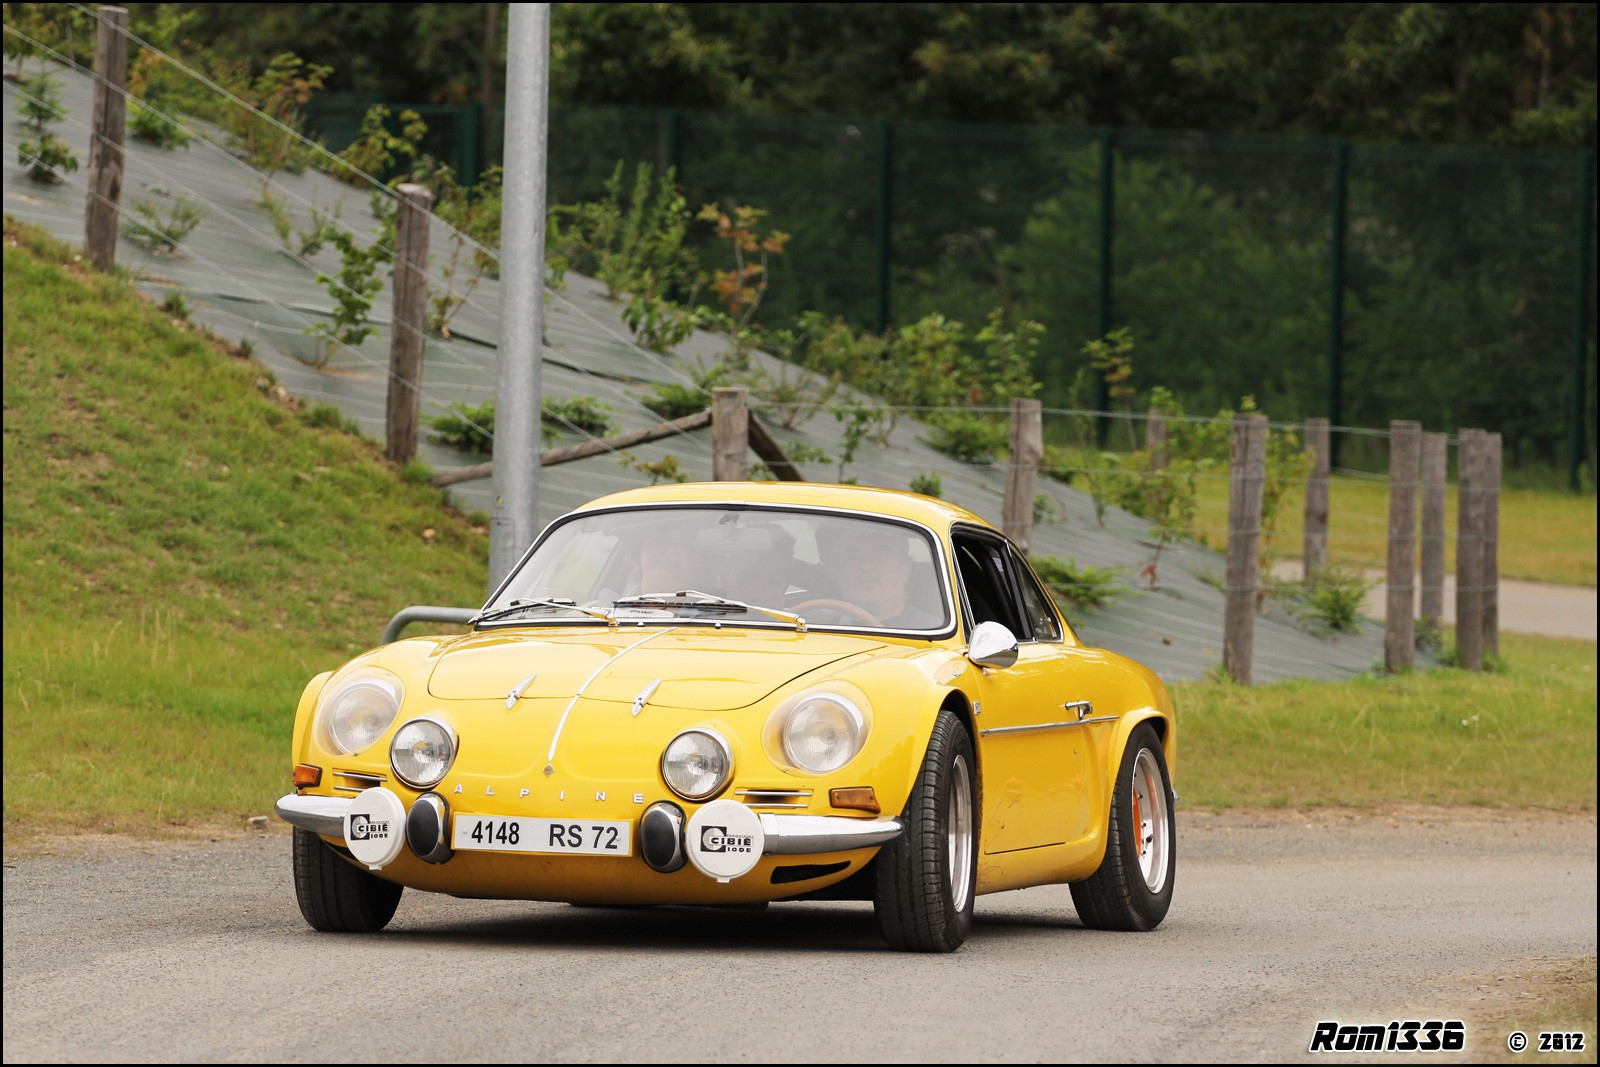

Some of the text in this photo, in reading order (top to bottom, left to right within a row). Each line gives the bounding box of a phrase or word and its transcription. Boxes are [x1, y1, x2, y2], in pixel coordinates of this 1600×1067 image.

[453, 783, 645, 804] ALPINE
[471, 820, 620, 850] 4148 RS 72
